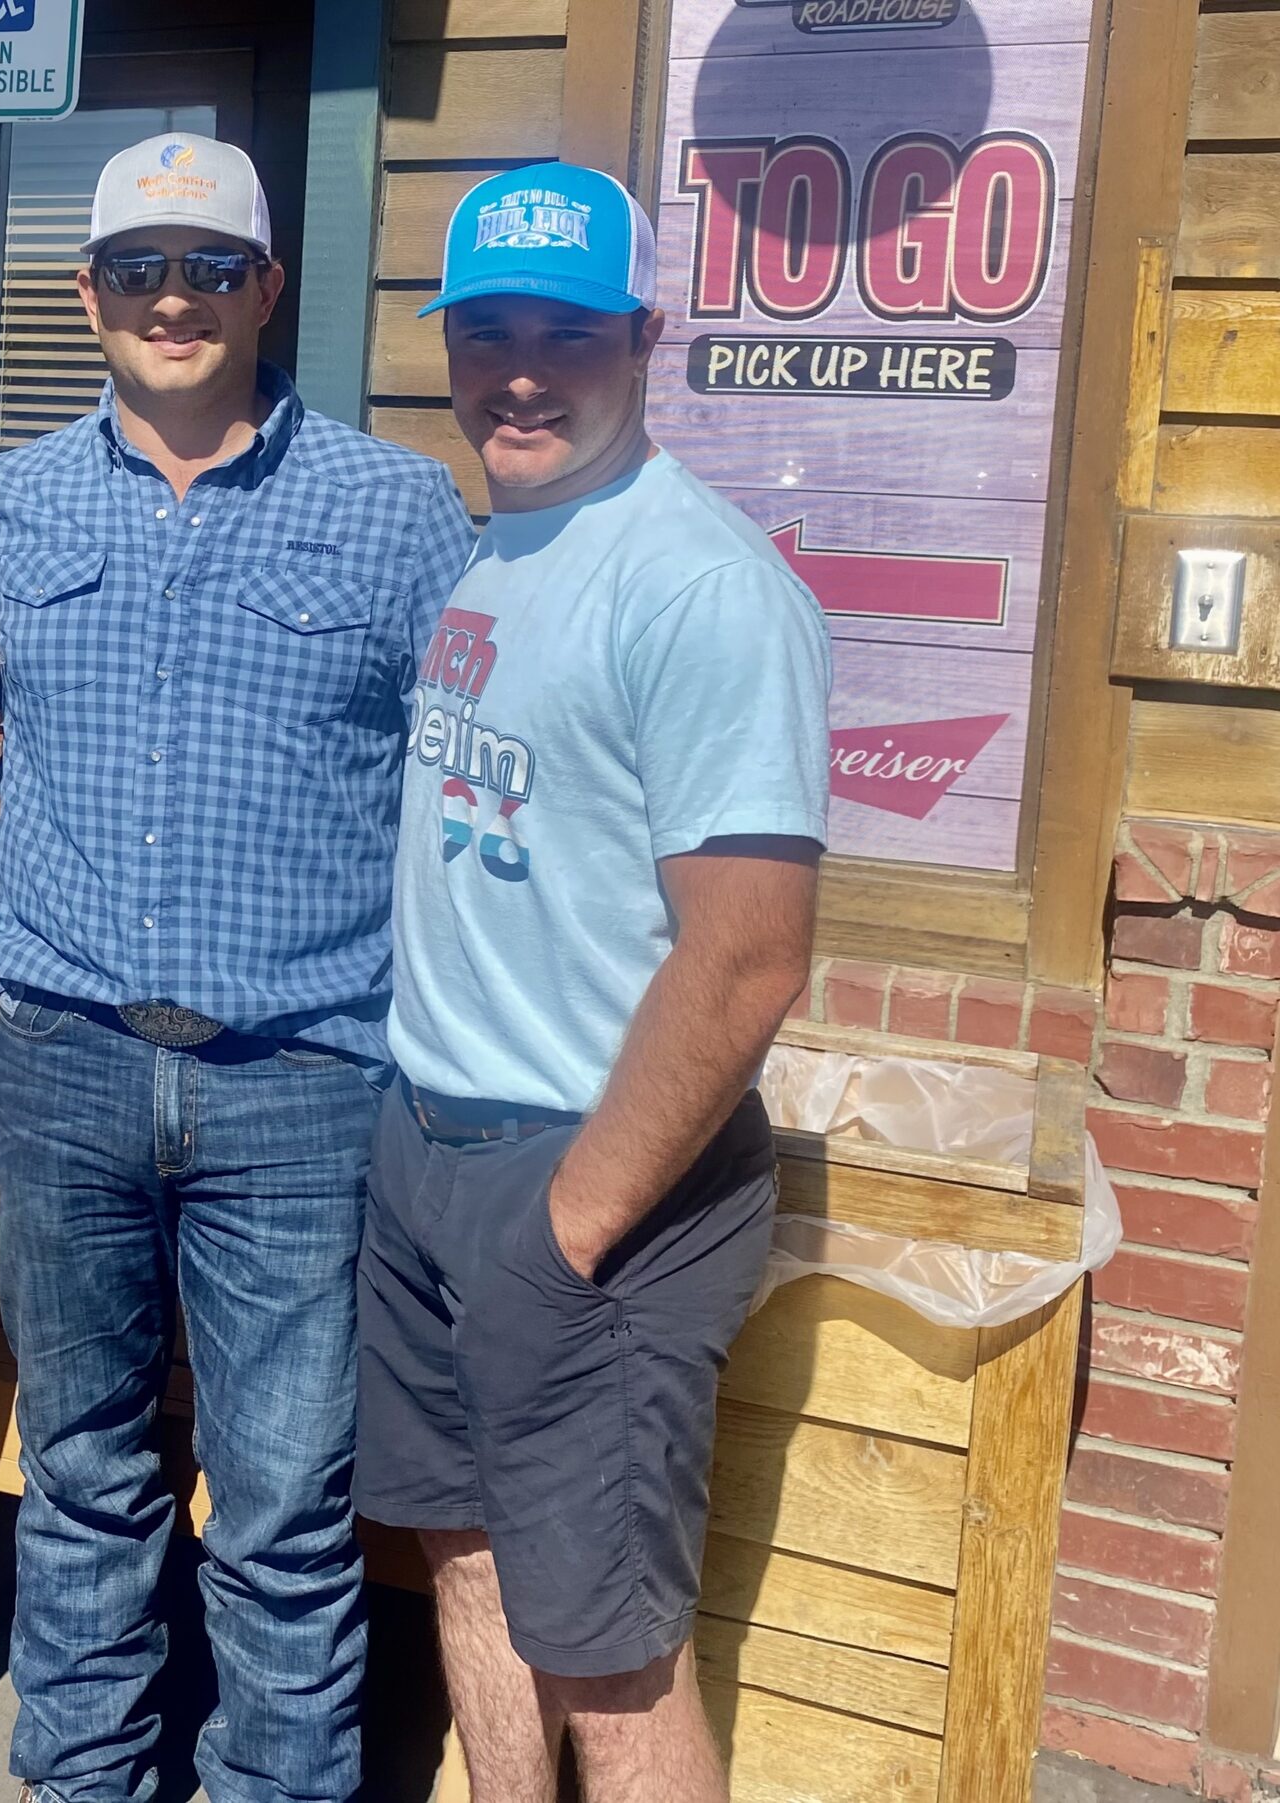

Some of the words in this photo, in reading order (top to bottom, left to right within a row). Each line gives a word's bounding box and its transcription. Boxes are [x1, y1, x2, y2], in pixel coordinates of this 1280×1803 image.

[798, 0, 953, 24] ROADHOUSE
[167, 172, 217, 191] Control
[500, 191, 528, 208] THAT'S
[530, 189, 543, 204] NO
[475, 208, 527, 250] BILL
[680, 136, 851, 321] TO
[859, 132, 1055, 323] GO
[707, 344, 801, 386] PICK
[810, 346, 868, 387] UP
[879, 346, 994, 390] HERE
[286, 540, 341, 555] RESISTOL
